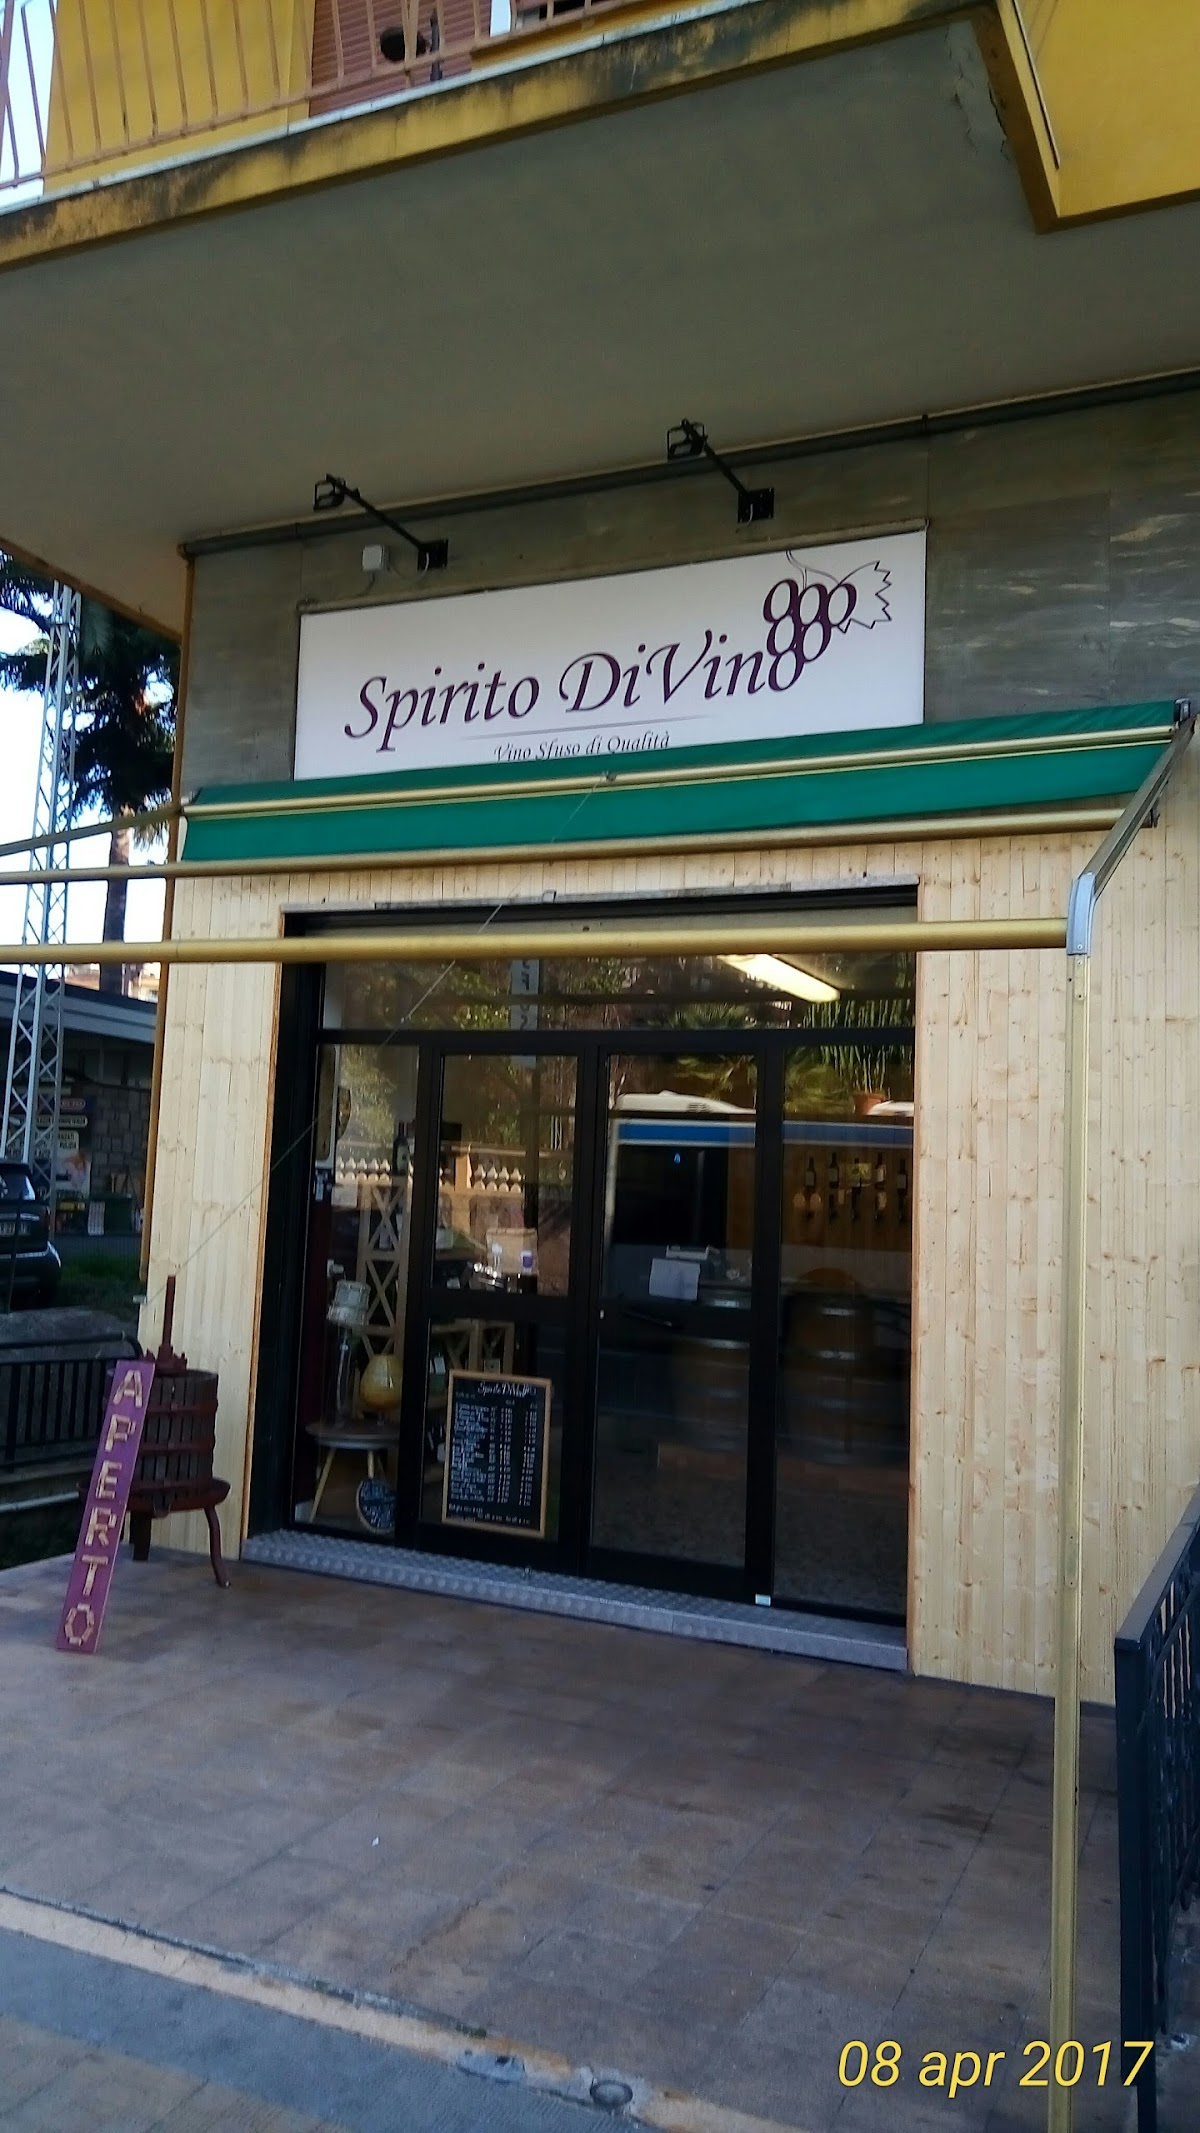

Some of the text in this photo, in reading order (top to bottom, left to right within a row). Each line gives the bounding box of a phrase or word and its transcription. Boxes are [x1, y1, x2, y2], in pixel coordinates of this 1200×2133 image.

[344, 628, 806, 754] Spirito DiVino
[493, 730, 671, 763] Vino Sfuso di Qualità
[64, 1369, 144, 1647] APERTO
